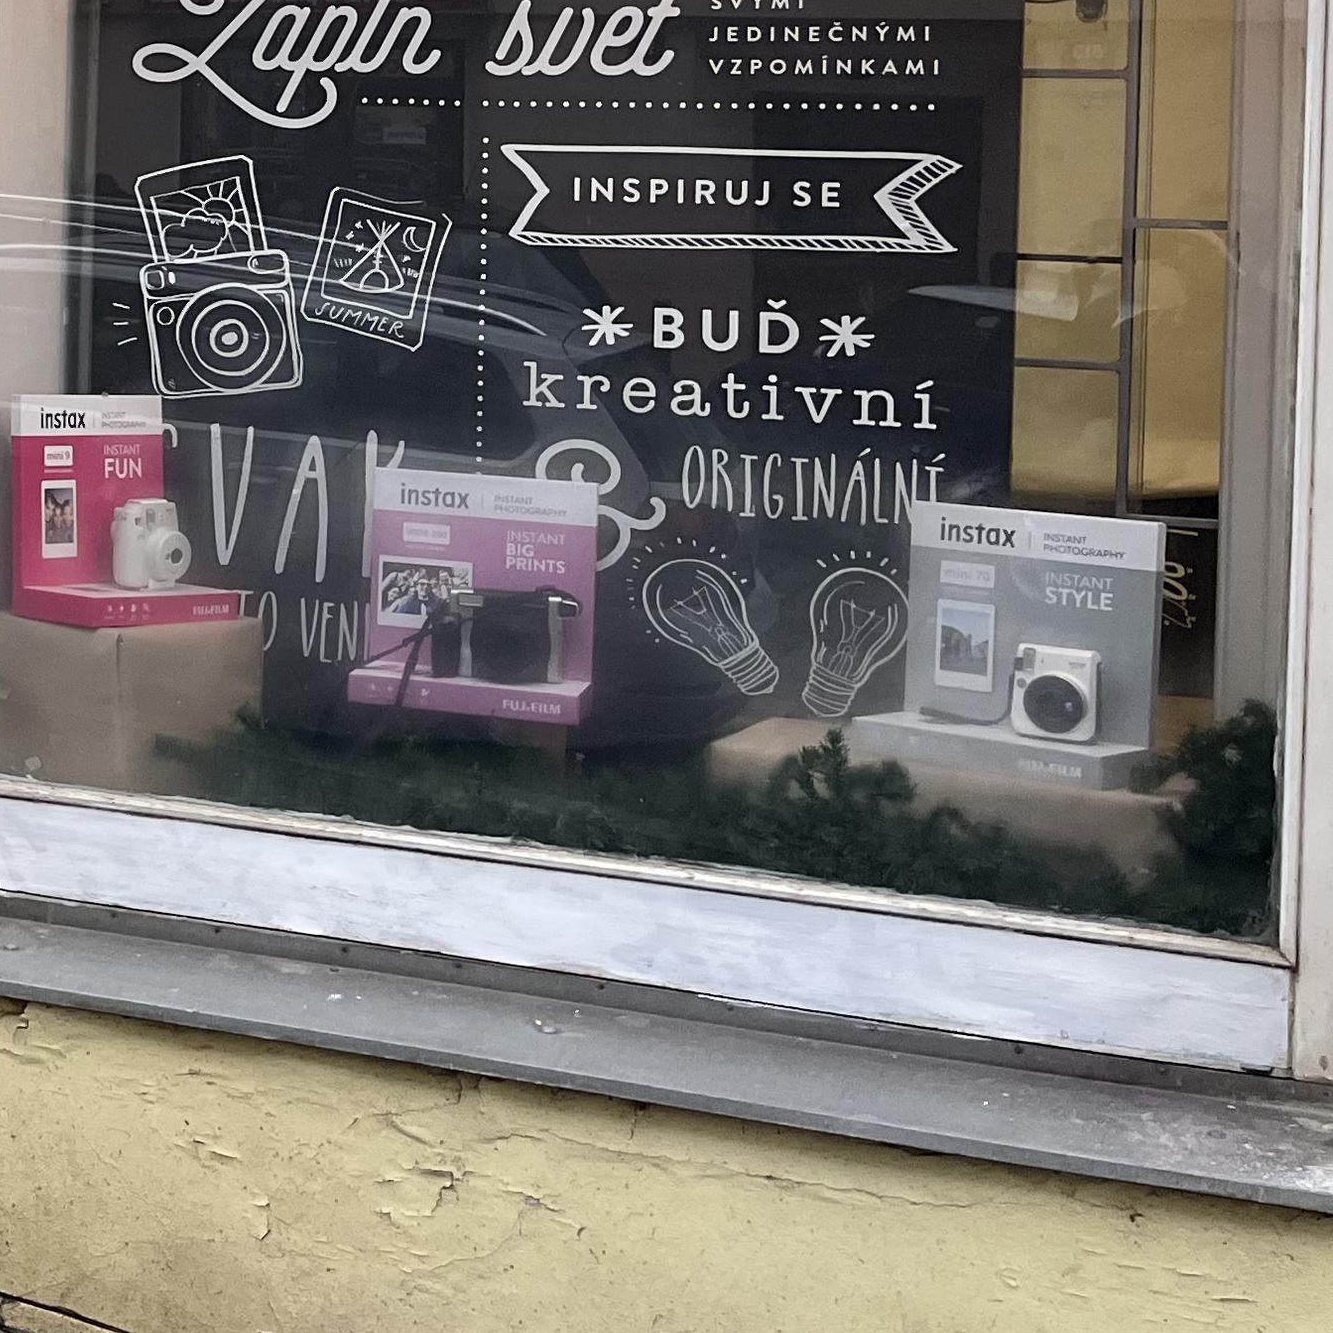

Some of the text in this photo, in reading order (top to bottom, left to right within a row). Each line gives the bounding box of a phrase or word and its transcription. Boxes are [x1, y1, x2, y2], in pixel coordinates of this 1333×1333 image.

[708, 21, 931, 42] JEDINEČNÝMI
[708, 55, 940, 75] VZPOMÍNKAMI
[573, 177, 842, 208] INSPIRUJ SE
[315, 302, 405, 339] SUMMER
[653, 299, 800, 354] BUĎ
[522, 361, 938, 430] kreativní
[40, 407, 86, 429] instax
[103, 444, 141, 456] INSTANT
[104, 458, 142, 479] FUN
[680, 444, 947, 526] ORIGINÁLNÍ
[400, 483, 470, 510] instax
[494, 495, 533, 506] INSTANT
[493, 504, 568, 517] PHOTOGRAPHY
[506, 530, 566, 545] INSTANT
[940, 516, 1016, 548] instax
[1043, 533, 1087, 544] INSTANT
[506, 544, 535, 558] BIG
[1043, 544, 1126, 560] PHOTOGRAPHY
[506, 557, 566, 575] PRINTS
[1044, 571, 1114, 590] INSTANT
[1044, 587, 1114, 612] STYLE
[300, 597, 371, 663] VEN
